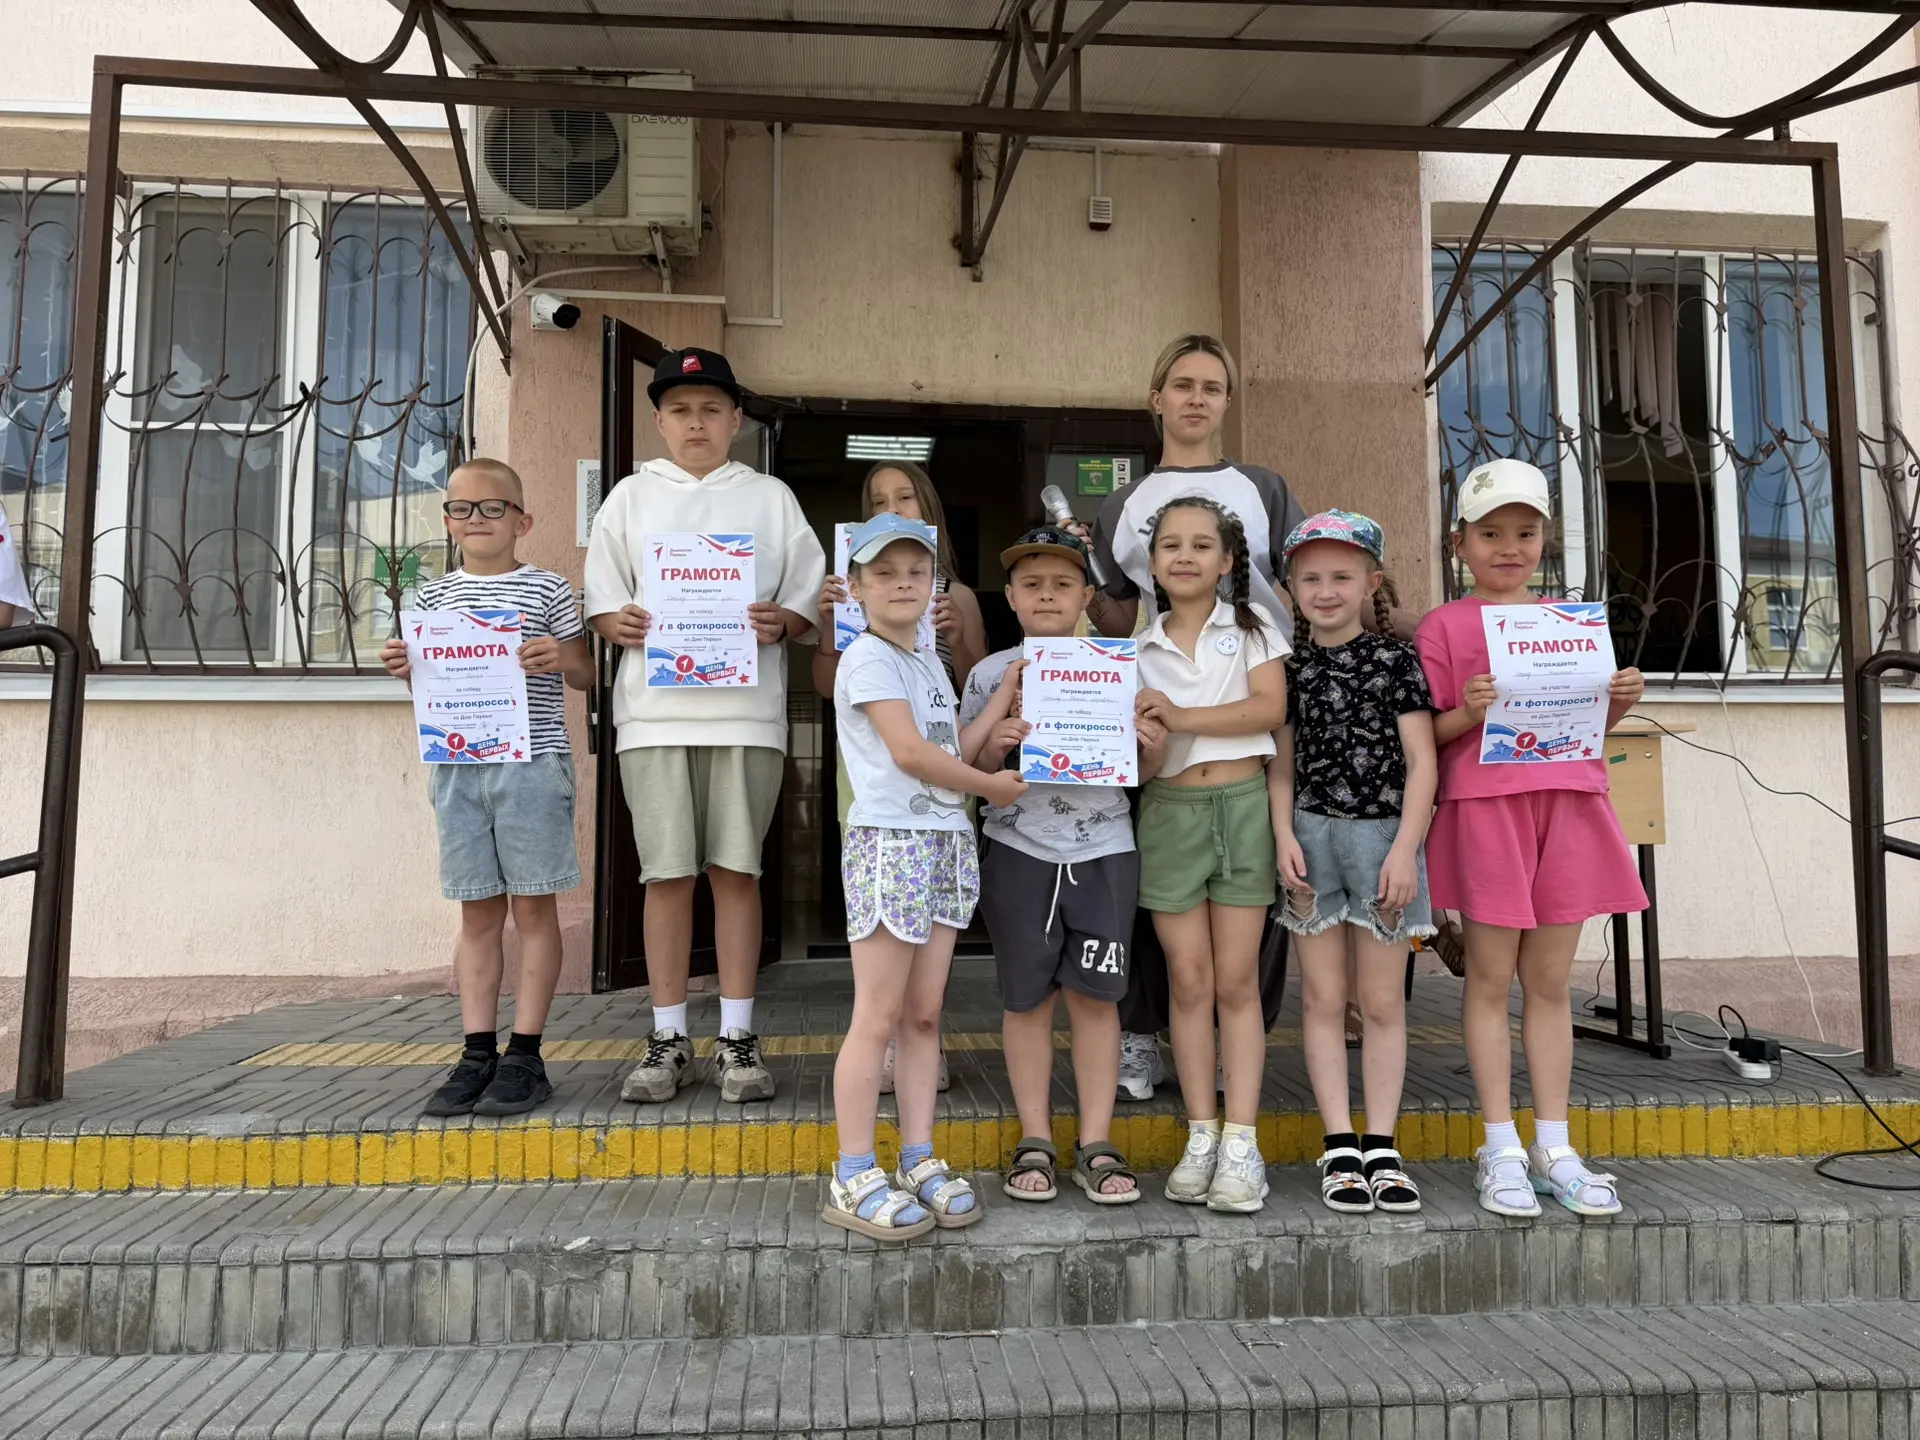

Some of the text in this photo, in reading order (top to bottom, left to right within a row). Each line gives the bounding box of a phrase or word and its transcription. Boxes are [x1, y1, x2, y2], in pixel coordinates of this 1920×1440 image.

[632, 115, 688, 124] DAEWOO
[661, 568, 742, 581] ГРАМОТА
[677, 622, 739, 631] фотокроссе
[423, 644, 509, 659] ГРАМОТА
[1508, 638, 1598, 655] ГРАМОТА
[705, 664, 723, 672] ДЕНЬ
[707, 669, 736, 680] ПЕРВЫХ
[1041, 670, 1122, 683] ГРАМОТА
[445, 699, 510, 709] фотокроссе
[1526, 697, 1593, 708] фотокроссе
[1054, 721, 1118, 732] фотокроссе
[477, 741, 496, 750] ДЕНЬ
[1547, 739, 1566, 748] ДЕНЬ
[1548, 742, 1579, 754] ПЕРВЫХ
[480, 745, 509, 756] ПЕРВЫХ
[1083, 768, 1113, 778] ПЕРВЫХ
[1081, 939, 1124, 976] GA
